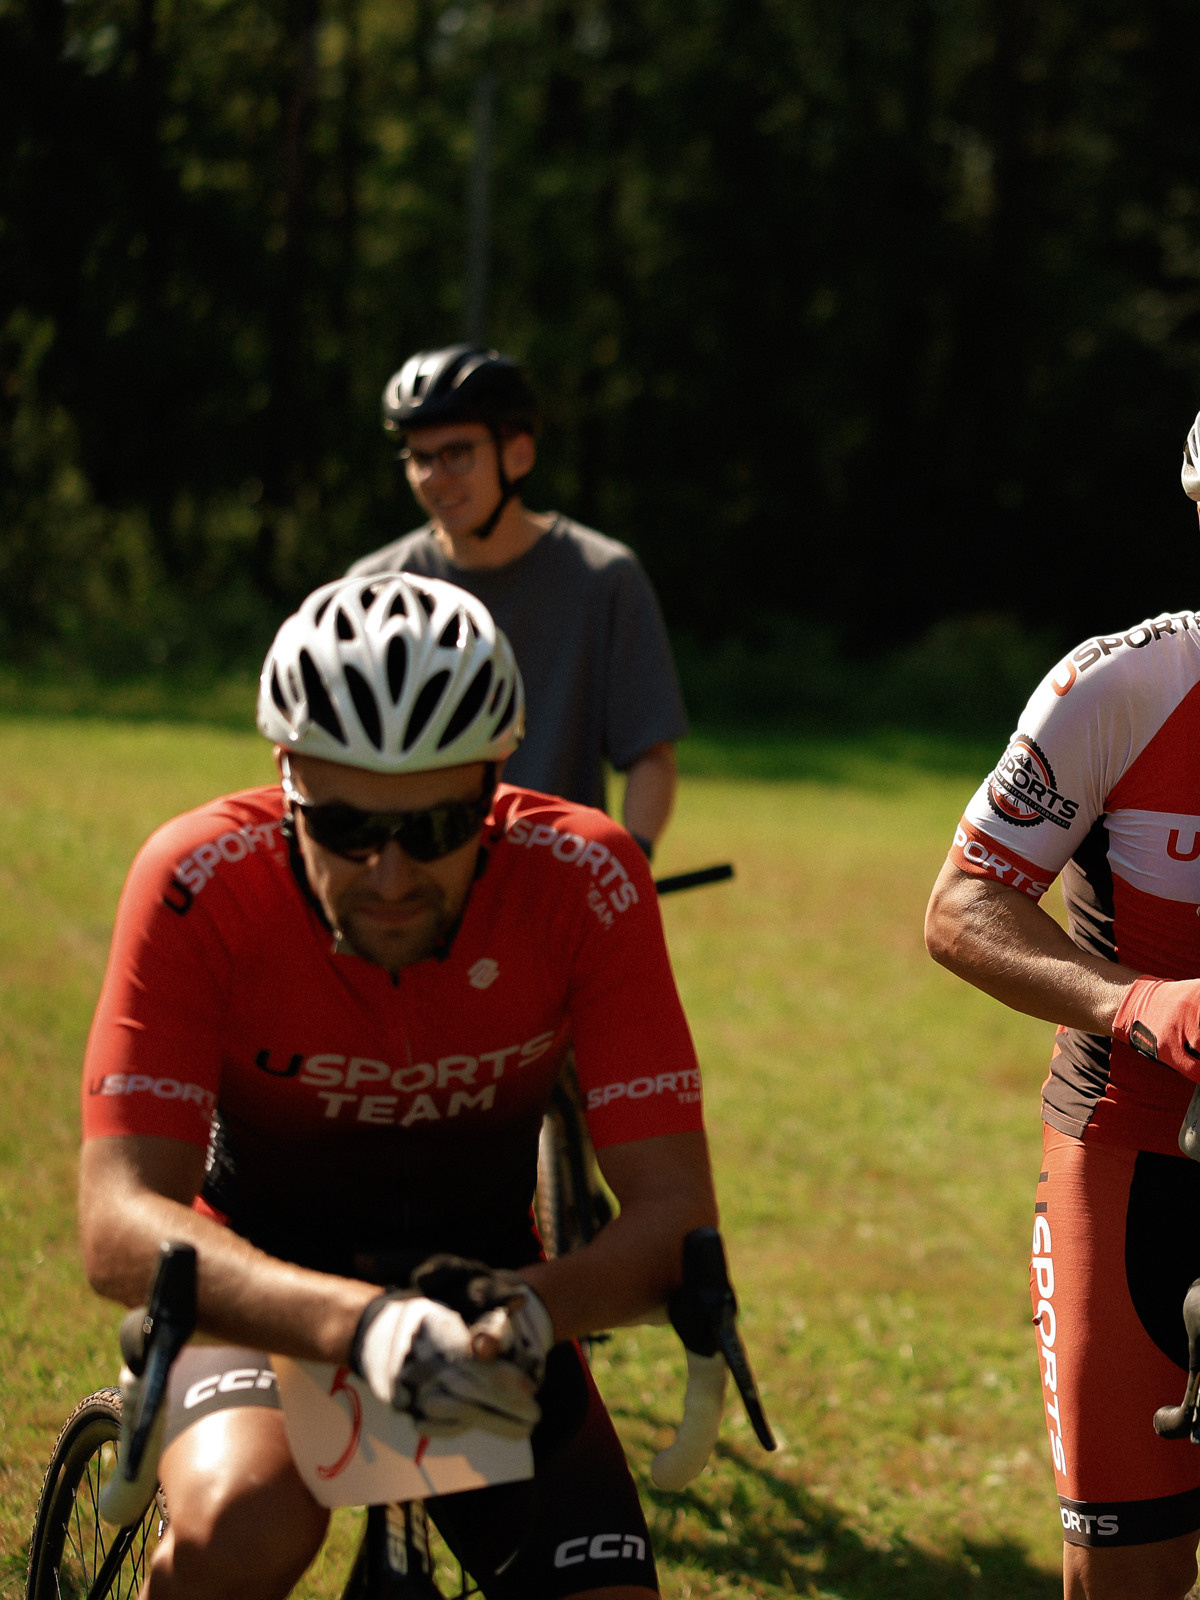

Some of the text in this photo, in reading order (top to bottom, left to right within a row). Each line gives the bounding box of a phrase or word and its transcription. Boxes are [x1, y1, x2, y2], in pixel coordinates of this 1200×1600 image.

[255, 1031, 556, 1092] USPORTS
[318, 1084, 497, 1128] TEAM
[1060, 1507, 1119, 1536] ORTS
